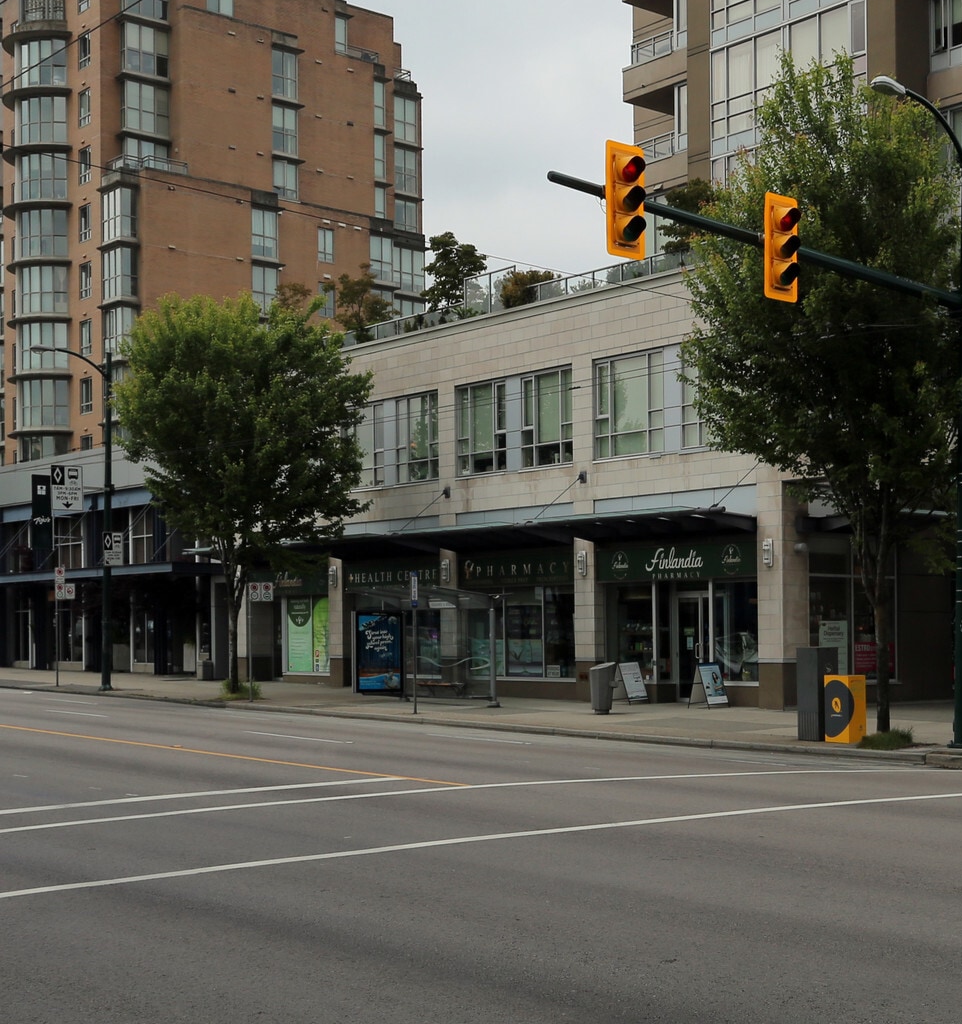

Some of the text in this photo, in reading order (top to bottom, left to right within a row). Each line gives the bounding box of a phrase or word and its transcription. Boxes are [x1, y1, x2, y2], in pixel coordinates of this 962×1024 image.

[645, 546, 704, 572] Finlandia
[354, 569, 437, 583] HEALTH CETRE
[476, 561, 569, 577] PHARMACY
[652, 571, 701, 580] PHARMACY
